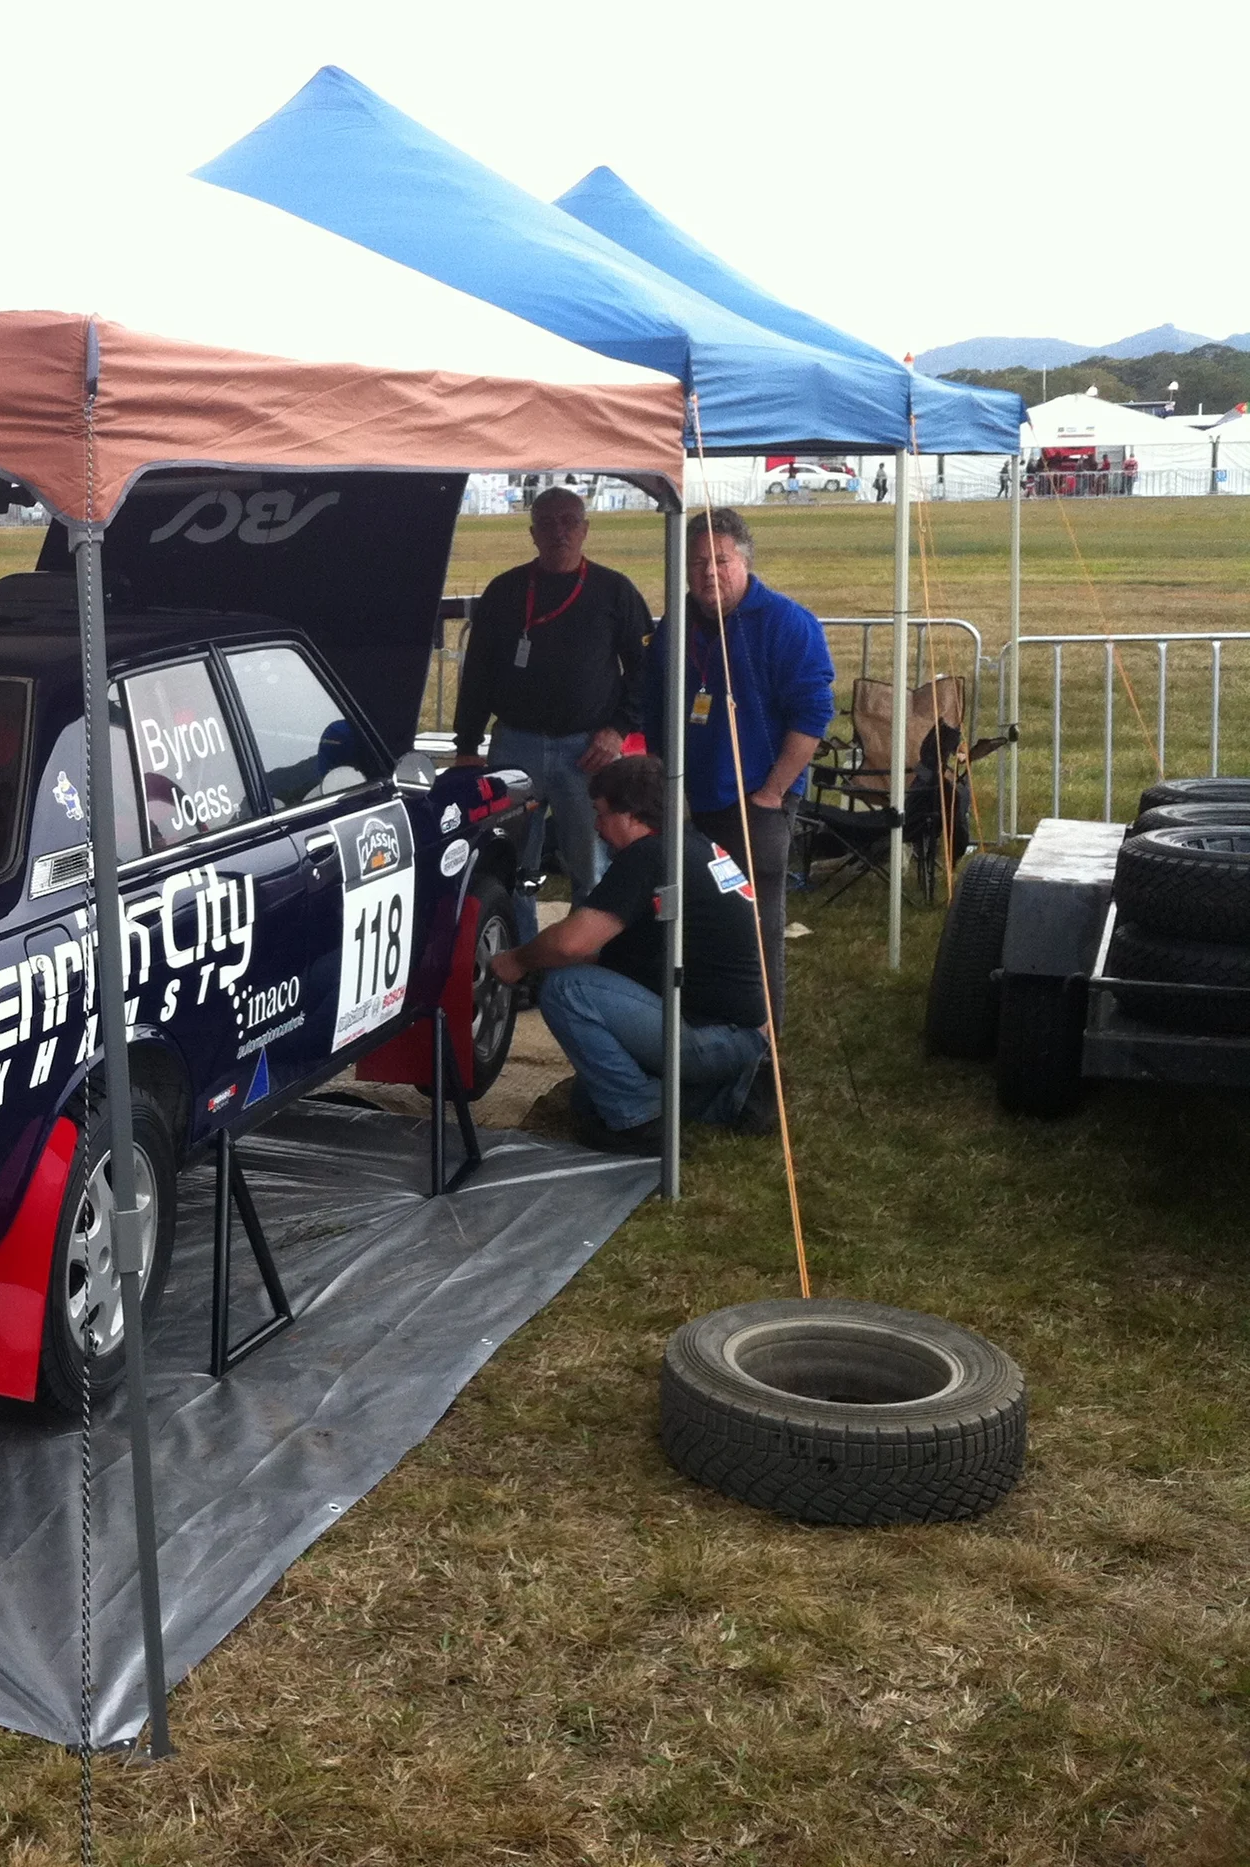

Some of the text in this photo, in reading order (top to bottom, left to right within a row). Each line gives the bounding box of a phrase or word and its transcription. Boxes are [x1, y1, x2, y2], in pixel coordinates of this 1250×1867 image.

[140, 716, 226, 780] Byron
[171, 784, 232, 831] Joass
[361, 832, 400, 871] CLASSIC
[161, 863, 254, 989] City
[354, 893, 402, 1005] 118
[246, 975, 300, 1029] inaco
